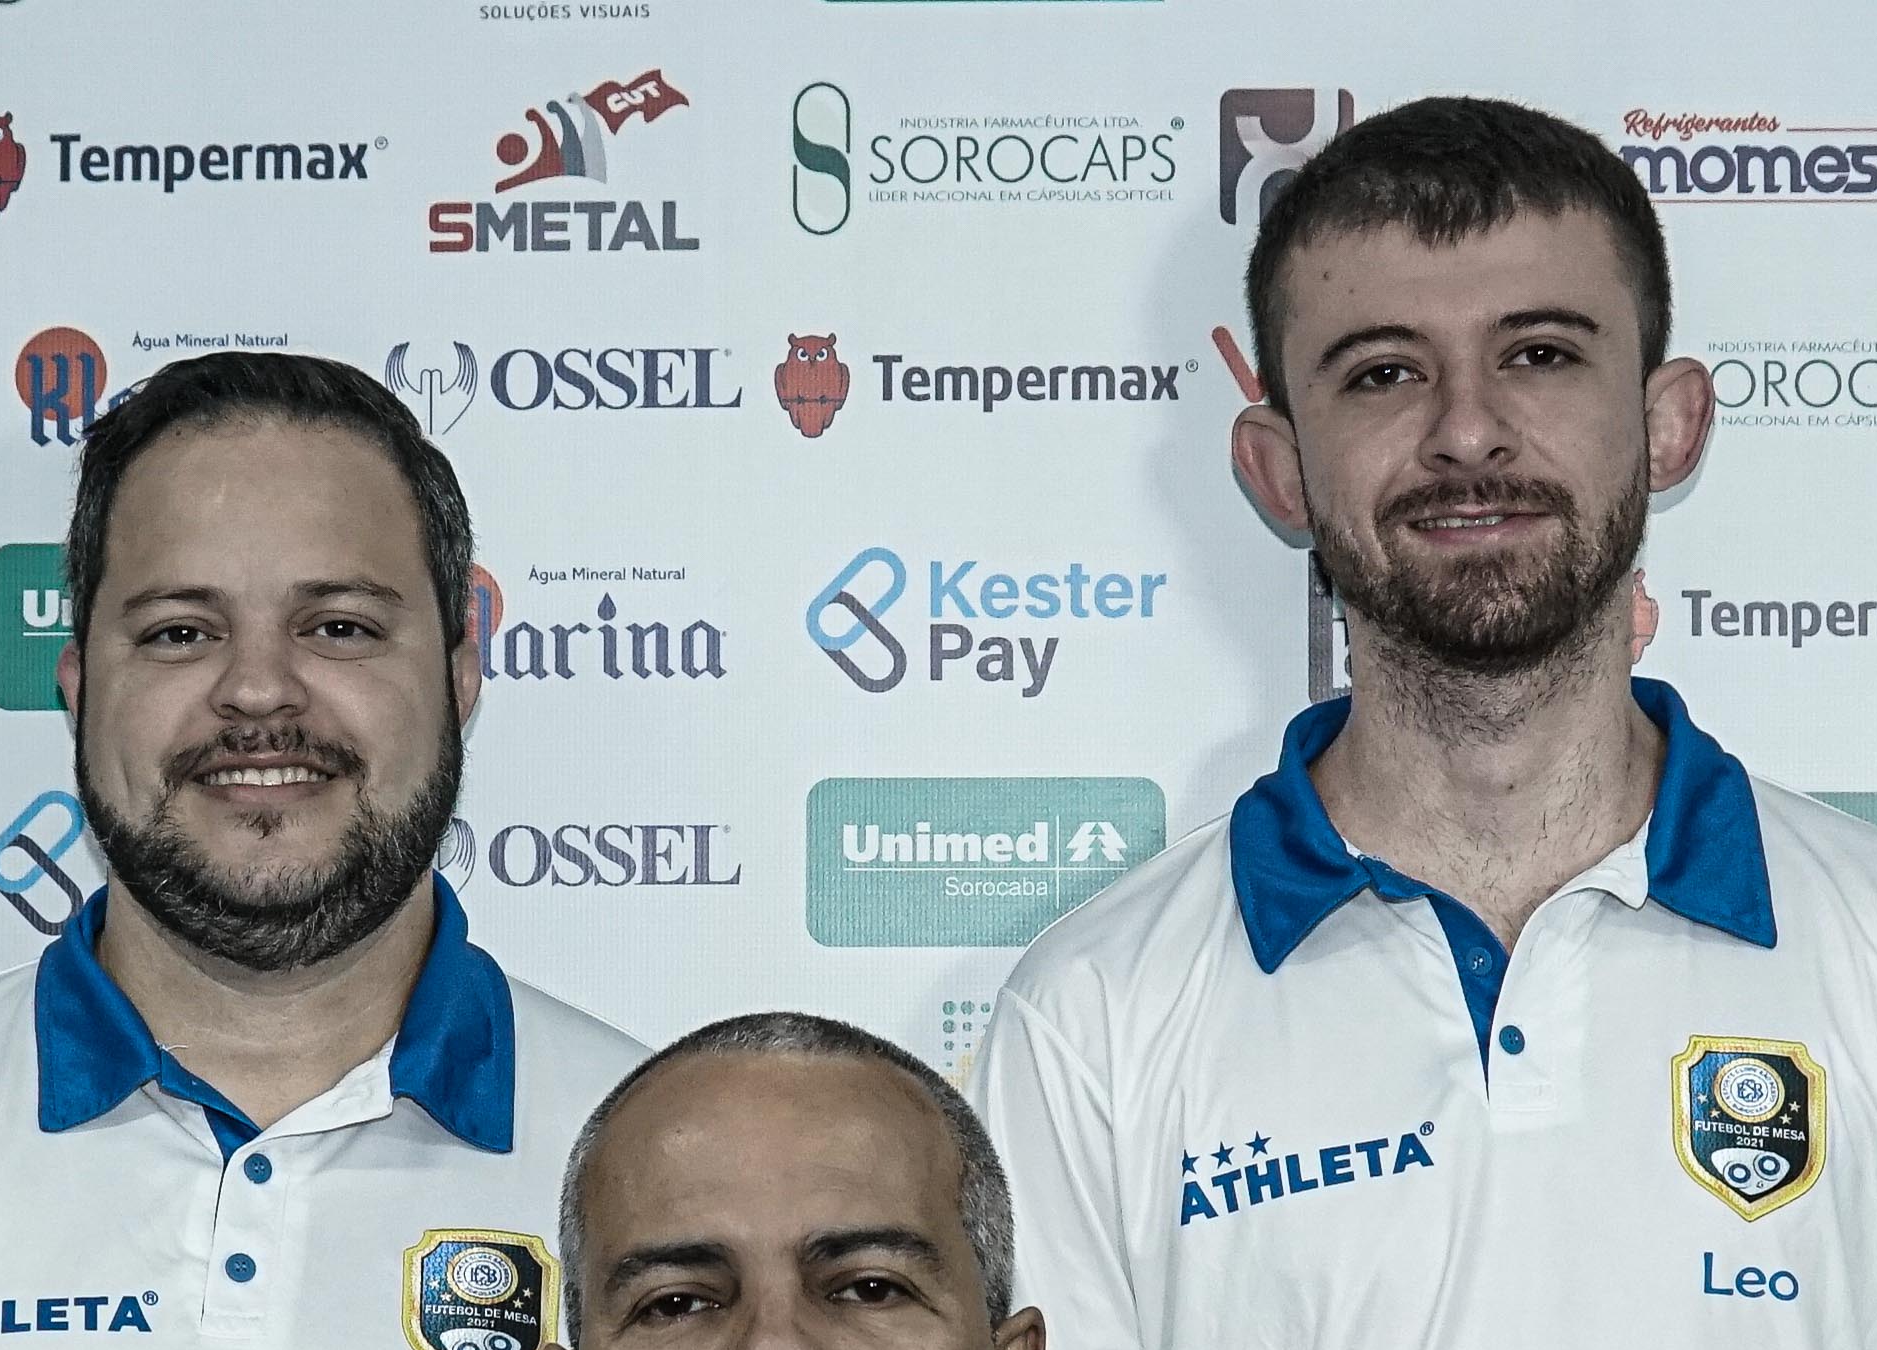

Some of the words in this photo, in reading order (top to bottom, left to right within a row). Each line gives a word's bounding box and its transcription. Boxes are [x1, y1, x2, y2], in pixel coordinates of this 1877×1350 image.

[579, 4, 651, 19] VISUAIS
[1622, 108, 1781, 140] Refrigerantes
[50, 134, 369, 193] Tempermax
[869, 134, 1177, 184] SOROCAPS
[913, 189, 994, 202] NACIONAL
[999, 189, 1022, 201] EM
[427, 201, 700, 253] SMETAL
[132, 333, 168, 350] Água
[175, 332, 227, 347] Mineral
[234, 332, 289, 347] Natural
[490, 347, 742, 410] OSSEL
[873, 353, 1179, 412] Tempermax
[1808, 414, 1827, 427] EM
[528, 565, 566, 584] Água
[572, 564, 627, 581] Mineral
[632, 564, 686, 581] Natural
[929, 560, 1167, 621] Kester
[929, 624, 1059, 699] Pay
[488, 823, 742, 887] OSSEL
[843, 822, 1049, 864] Unimed
[944, 875, 1049, 901] Sorocaba
[1694, 1120, 1751, 1136] FUTEBOL
[1752, 1125, 1770, 1137] DE
[1772, 1127, 1806, 1141] MESA
[1736, 1136, 1764, 1148] 2021
[1180, 1131, 1435, 1227] ATHLETA
[1703, 1252, 1800, 1301] Leo
[424, 1304, 482, 1317] FUTEBOL
[484, 1307, 501, 1319] DE
[504, 1309, 538, 1326] MESA
[466, 1316, 495, 1328] 2021
